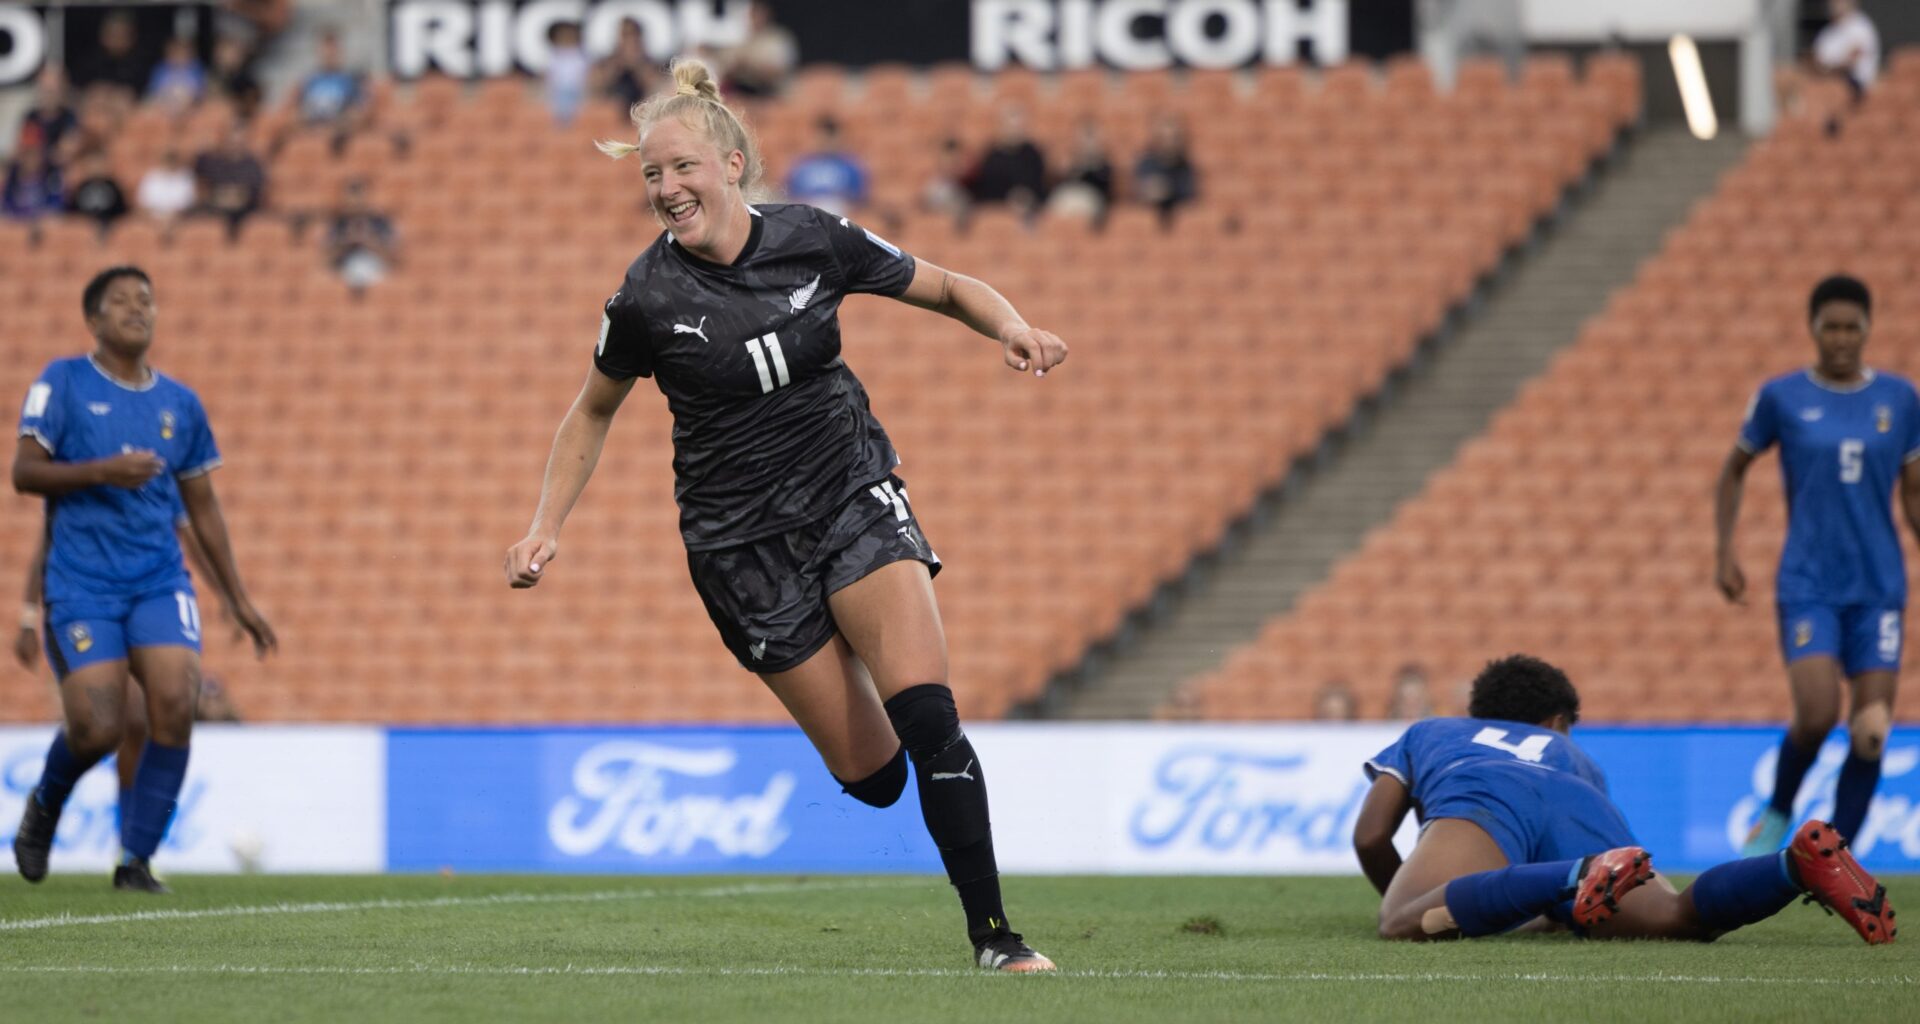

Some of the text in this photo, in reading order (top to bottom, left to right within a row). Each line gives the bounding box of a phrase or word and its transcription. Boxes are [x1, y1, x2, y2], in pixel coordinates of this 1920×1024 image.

[970, 0, 1349, 69] RICOH
[745, 331, 791, 394] 11
[1838, 438, 1865, 484] 5
[1471, 726, 1553, 763] 4
[547, 739, 796, 860] Ford
[1129, 743, 1367, 853] Ford
